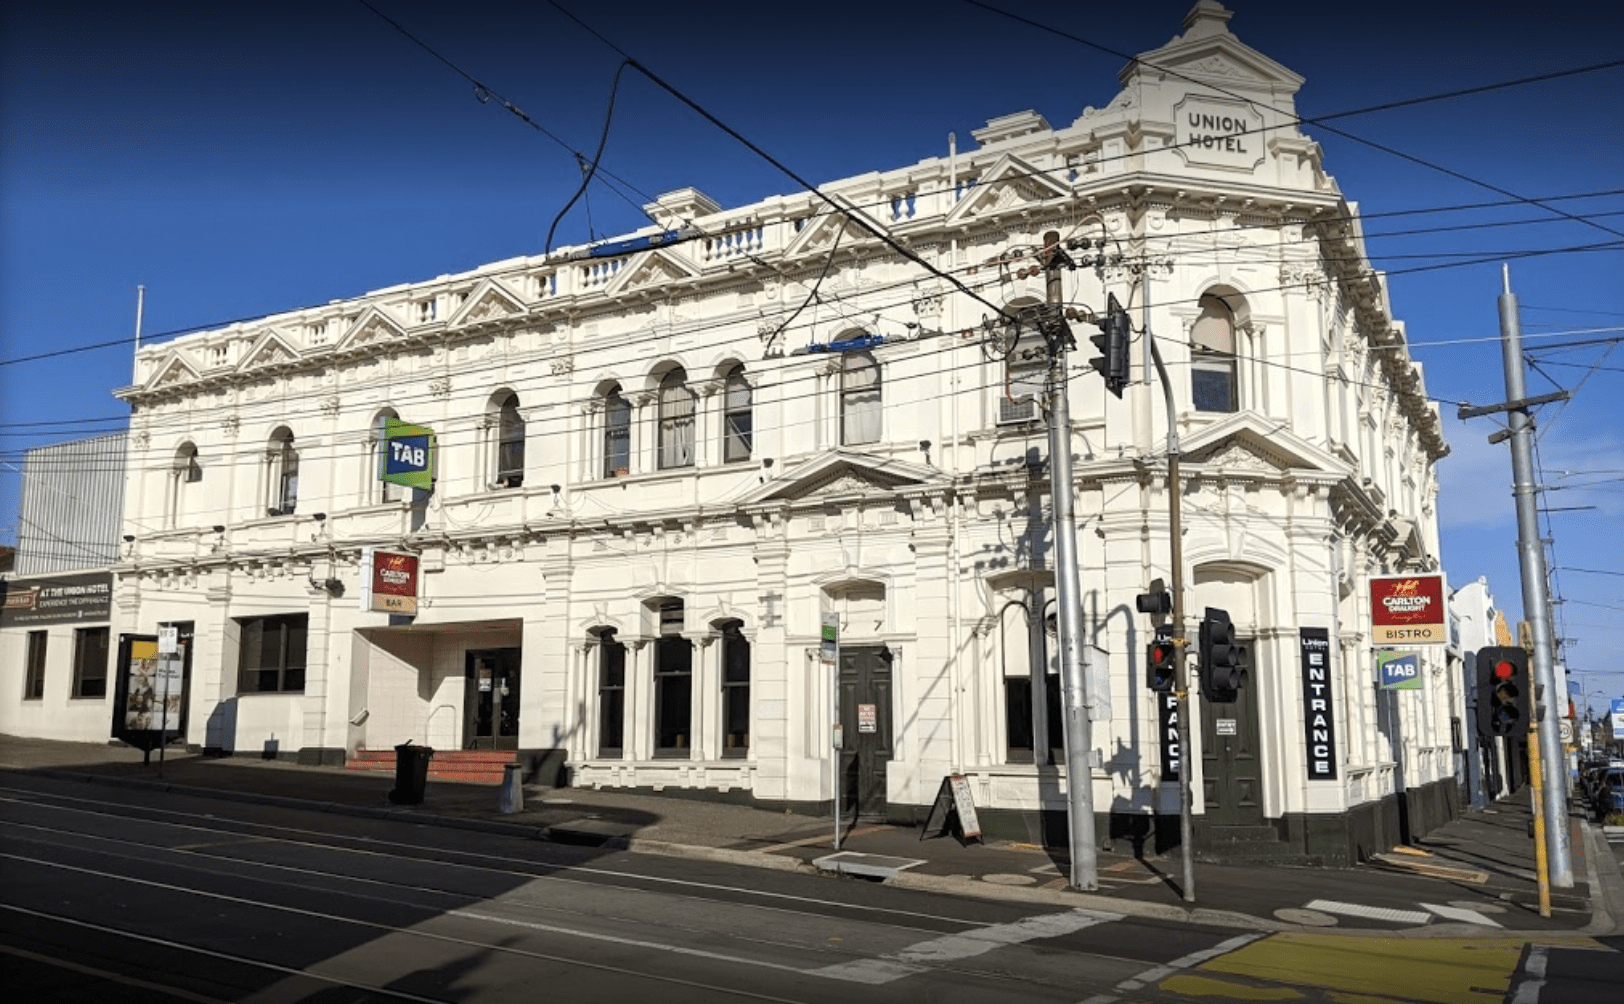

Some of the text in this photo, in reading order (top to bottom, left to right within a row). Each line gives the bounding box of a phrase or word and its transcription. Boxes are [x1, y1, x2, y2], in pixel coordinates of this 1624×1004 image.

[1188, 112, 1247, 133] UNION
[1188, 133, 1248, 154] HOTEL
[391, 441, 425, 467] TAB
[380, 568, 410, 580] CARLTON
[40, 588, 50, 598] AT
[63, 586, 86, 596] UNION
[86, 583, 109, 594] HOTEL
[386, 599, 402, 607] BAR
[1382, 596, 1431, 605] CARLTON
[1388, 604, 1426, 612] DRAUGHT
[1385, 629, 1432, 639] BISTRO
[1302, 638, 1329, 647] Union
[1385, 664, 1416, 676] TAB
[1308, 653, 1330, 774] ENTRANCE
